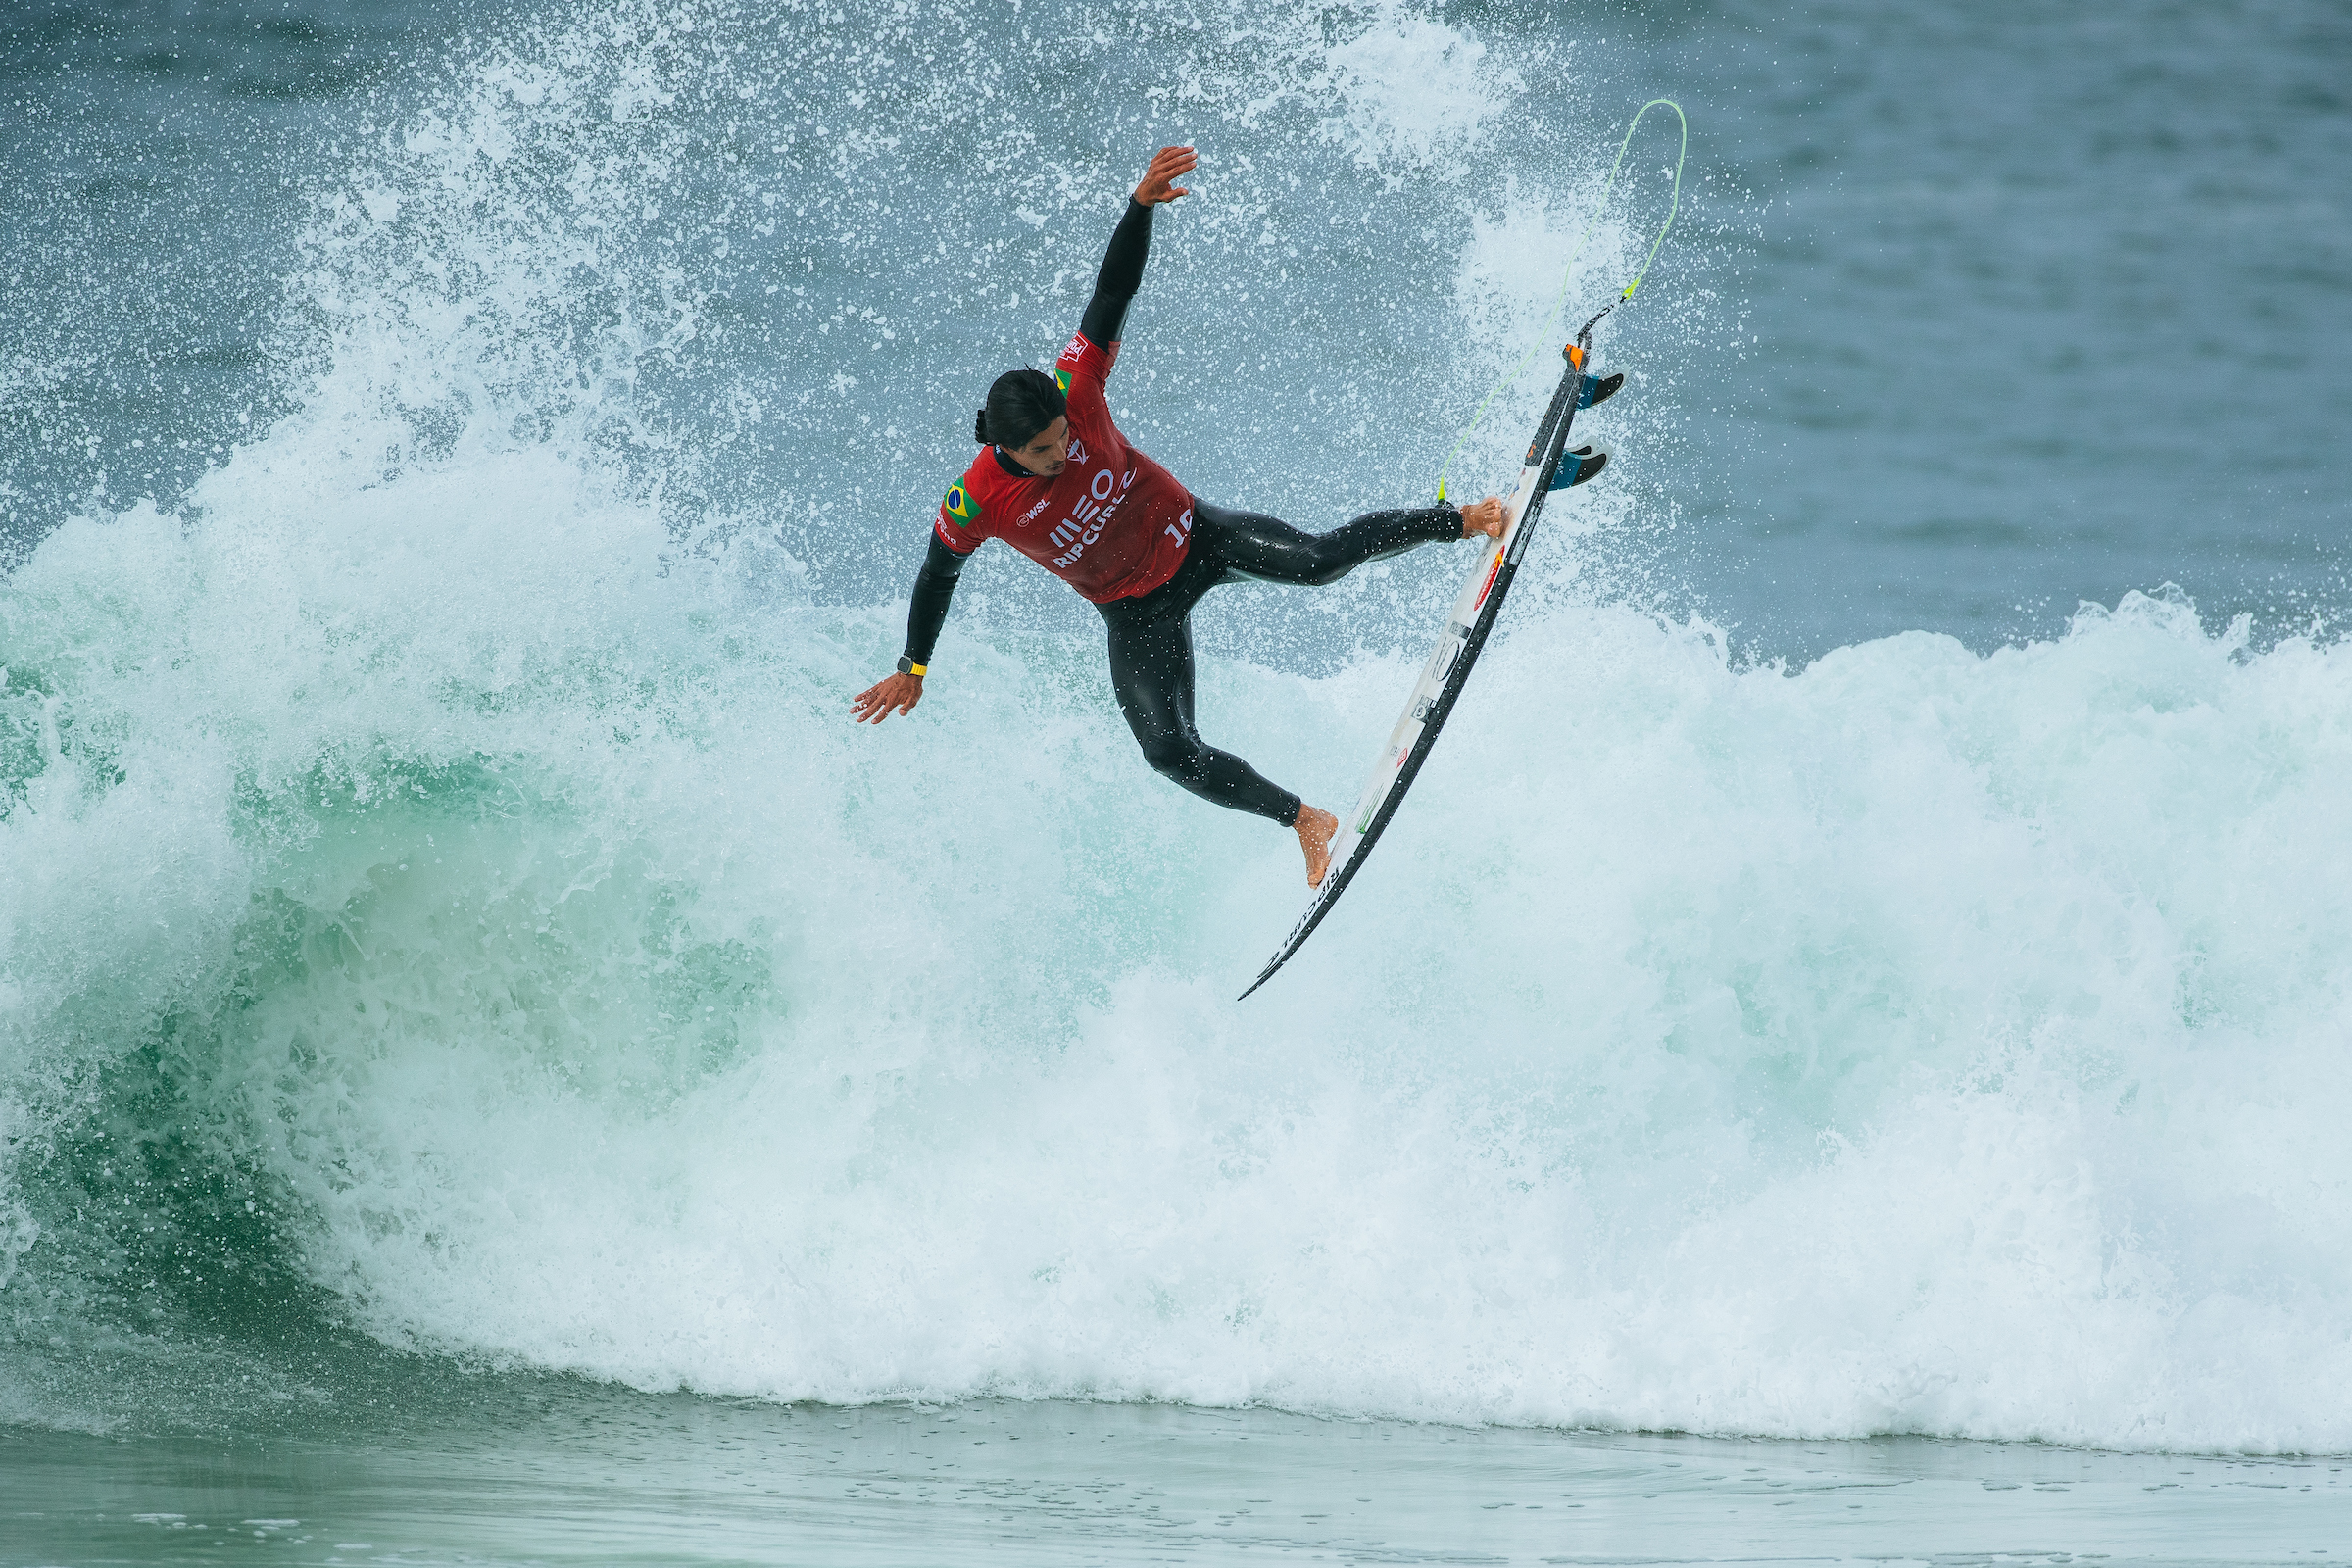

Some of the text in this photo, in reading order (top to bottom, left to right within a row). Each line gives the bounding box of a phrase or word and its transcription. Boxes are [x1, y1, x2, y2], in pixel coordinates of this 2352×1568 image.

[1025, 498, 1051, 521] WSL
[1049, 468, 1114, 549] MEO
[1052, 493, 1126, 569] RIP CURL
